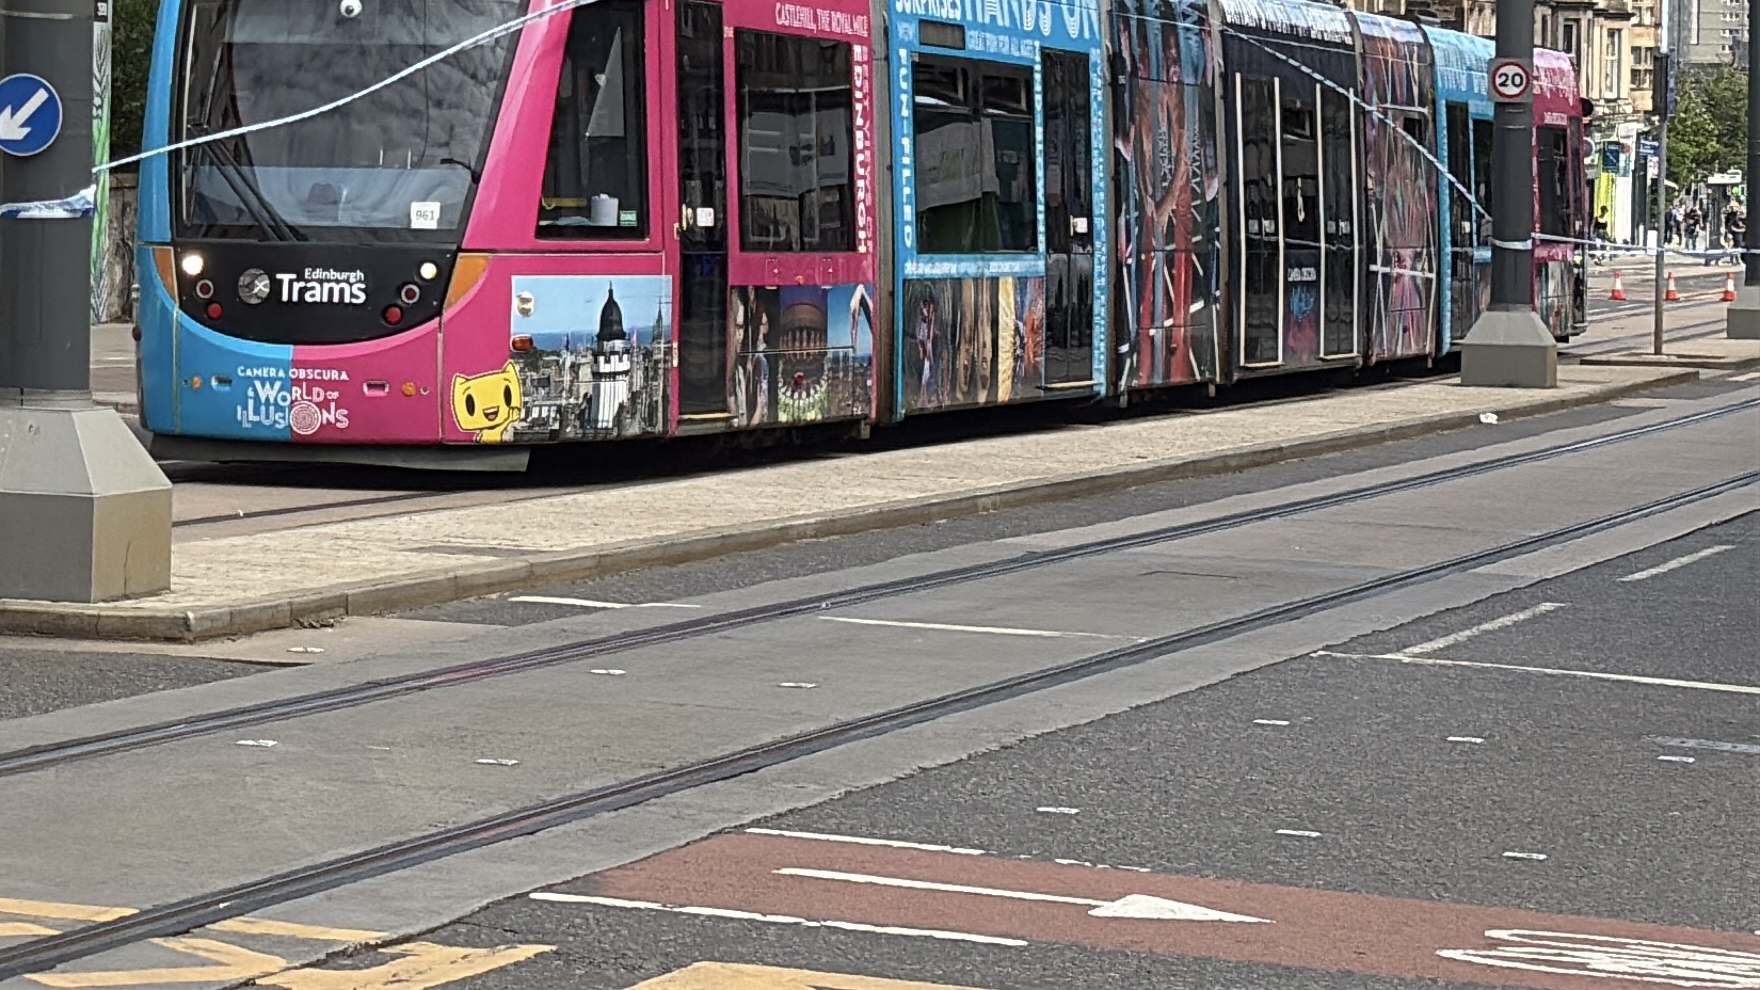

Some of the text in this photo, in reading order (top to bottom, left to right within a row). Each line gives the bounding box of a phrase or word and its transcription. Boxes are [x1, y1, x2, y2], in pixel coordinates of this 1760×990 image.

[1498, 72, 1524, 88] 20
[415, 210, 435, 221] 961
[304, 267, 365, 282] Edinburgh
[276, 273, 367, 304] Trams
[237, 365, 350, 381] CAMERA OBSCURA
[253, 380, 325, 407] WORLD
[236, 397, 350, 435] ILLUSIONS
